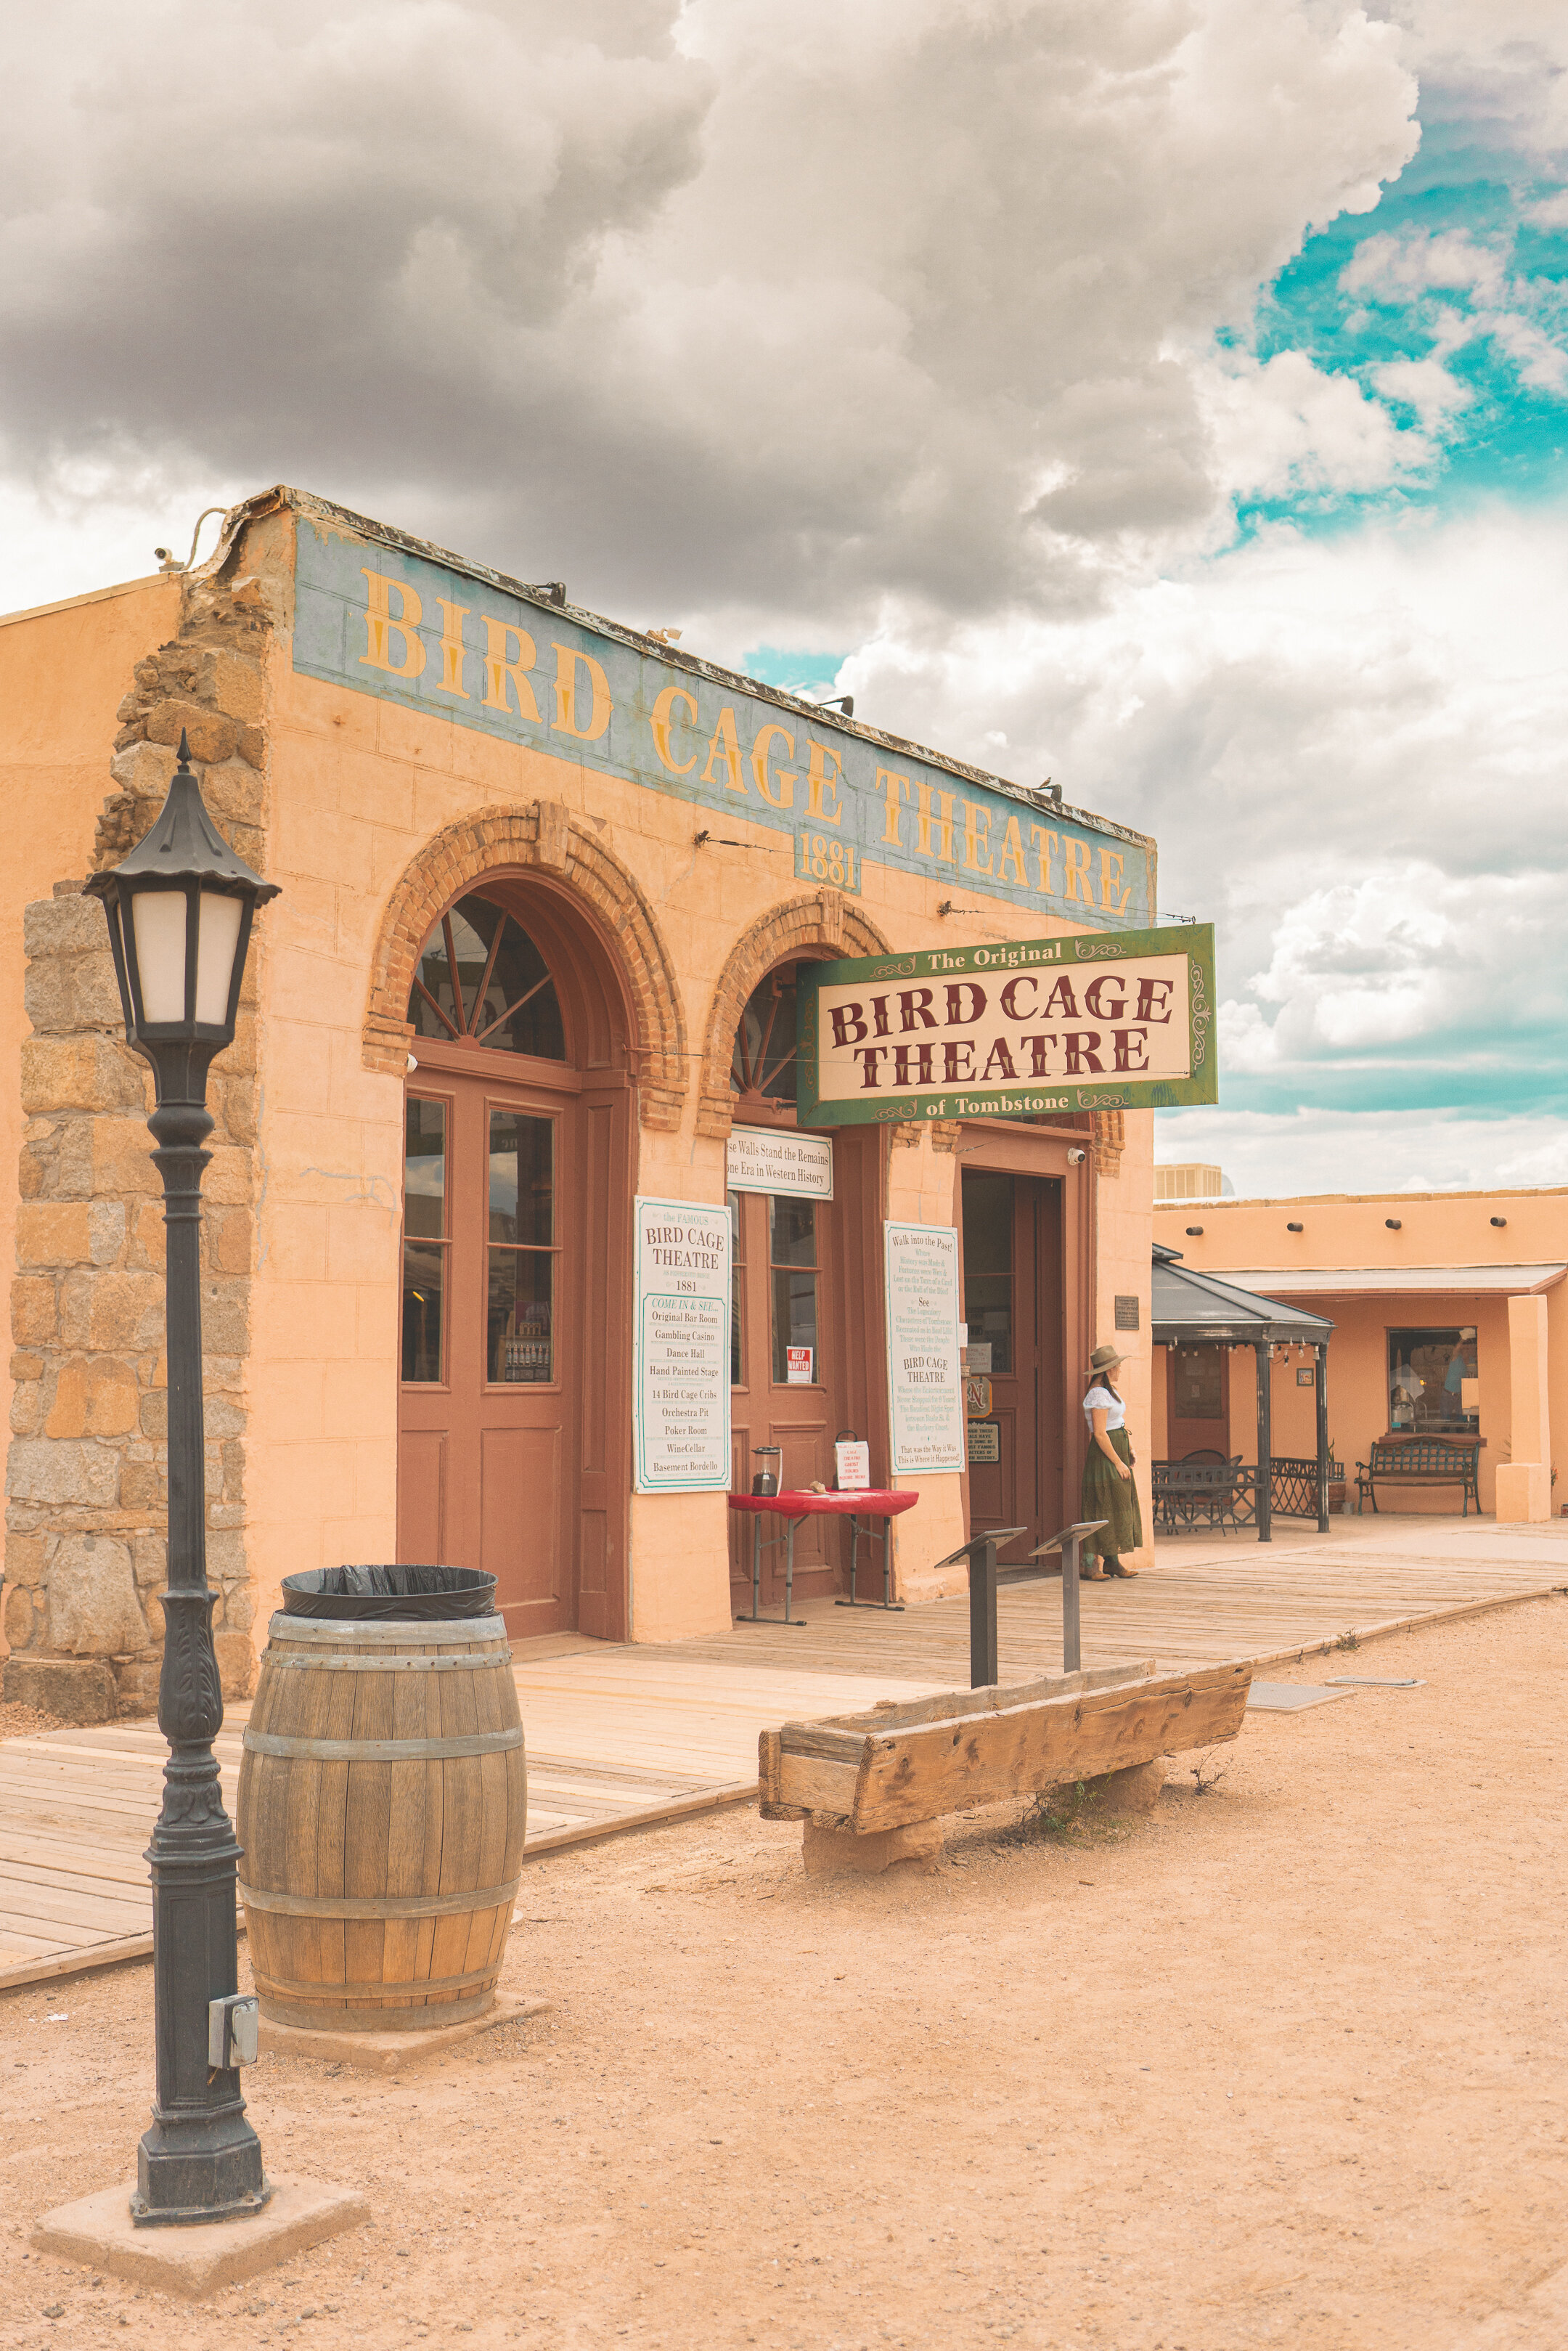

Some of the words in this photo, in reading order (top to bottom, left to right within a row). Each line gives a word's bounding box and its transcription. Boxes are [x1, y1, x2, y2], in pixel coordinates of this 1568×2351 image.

[359, 567, 614, 741] BIRD
[648, 687, 843, 826] CAGE
[875, 766, 1131, 918] THEATRE
[800, 833, 856, 889] 1881
[928, 953, 965, 971] The
[973, 942, 1062, 967] Original
[828, 982, 988, 1049] BIRD
[1000, 975, 1174, 1024] CAGE
[853, 1027, 1150, 1089] THEATRE
[926, 1099, 945, 1117] of
[955, 1093, 1069, 1115] Tombstone
[727, 1144, 737, 1153] se
[738, 1140, 759, 1156] Walls
[761, 1143, 783, 1160] Stand
[784, 1147, 796, 1161] the
[798, 1149, 829, 1165] Remains
[740, 1161, 754, 1176] Era
[756, 1163, 764, 1177] in
[765, 1164, 796, 1181] Western
[798, 1168, 825, 1187] History
[663, 1212, 676, 1222] the
[677, 1213, 709, 1226] FAMOUS
[645, 1226, 684, 1244] BIRD
[687, 1228, 724, 1252] CAGE
[892, 1234, 910, 1247] Walk
[910, 1234, 924, 1244] into
[925, 1235, 936, 1247] the
[936, 1238, 952, 1252] Past!
[653, 1248, 719, 1270] THEATRE
[900, 1256, 918, 1266] History
[928, 1258, 941, 1267] Made
[899, 1266, 920, 1274] Fortunes
[893, 1274, 904, 1283] Lost
[677, 1280, 697, 1292] 1881
[652, 1298, 677, 1309] COME
[679, 1300, 689, 1310] IN
[690, 1300, 697, 1311] &
[918, 1297, 930, 1307] See
[652, 1311, 683, 1322] Original
[685, 1313, 698, 1322] Bar
[699, 1313, 718, 1324] Room
[917, 1307, 942, 1319] Legendary
[896, 1315, 922, 1324] Characters
[655, 1329, 690, 1342] Gambling
[692, 1331, 715, 1341] Casino
[934, 1336, 950, 1345] People
[666, 1348, 689, 1358] Dance
[690, 1348, 705, 1358] Hall
[791, 1350, 806, 1360] HELP
[788, 1360, 809, 1371] WANTED
[903, 1356, 925, 1370] BIRD
[926, 1356, 948, 1371] CAGE
[650, 1365, 670, 1375] Hand
[672, 1366, 699, 1376] Painted
[701, 1366, 719, 1377] Stage
[907, 1371, 945, 1382] THEATRE
[652, 1390, 661, 1398] 14
[663, 1389, 679, 1398] Bird
[681, 1390, 698, 1401] Cage
[700, 1390, 717, 1399] Cribs
[897, 1385, 912, 1394] Where
[661, 1407, 698, 1417] Orchestra
[699, 1407, 709, 1417] Pit
[931, 1404, 944, 1414] Night
[944, 1405, 955, 1414] Spot
[664, 1425, 687, 1435] Poker
[687, 1425, 708, 1435] Room
[901, 1445, 912, 1454] That
[931, 1444, 943, 1454] Way
[936, 1453, 960, 1463] Happened!
[653, 1462, 688, 1472] Basement
[690, 1460, 718, 1470] Bordello
